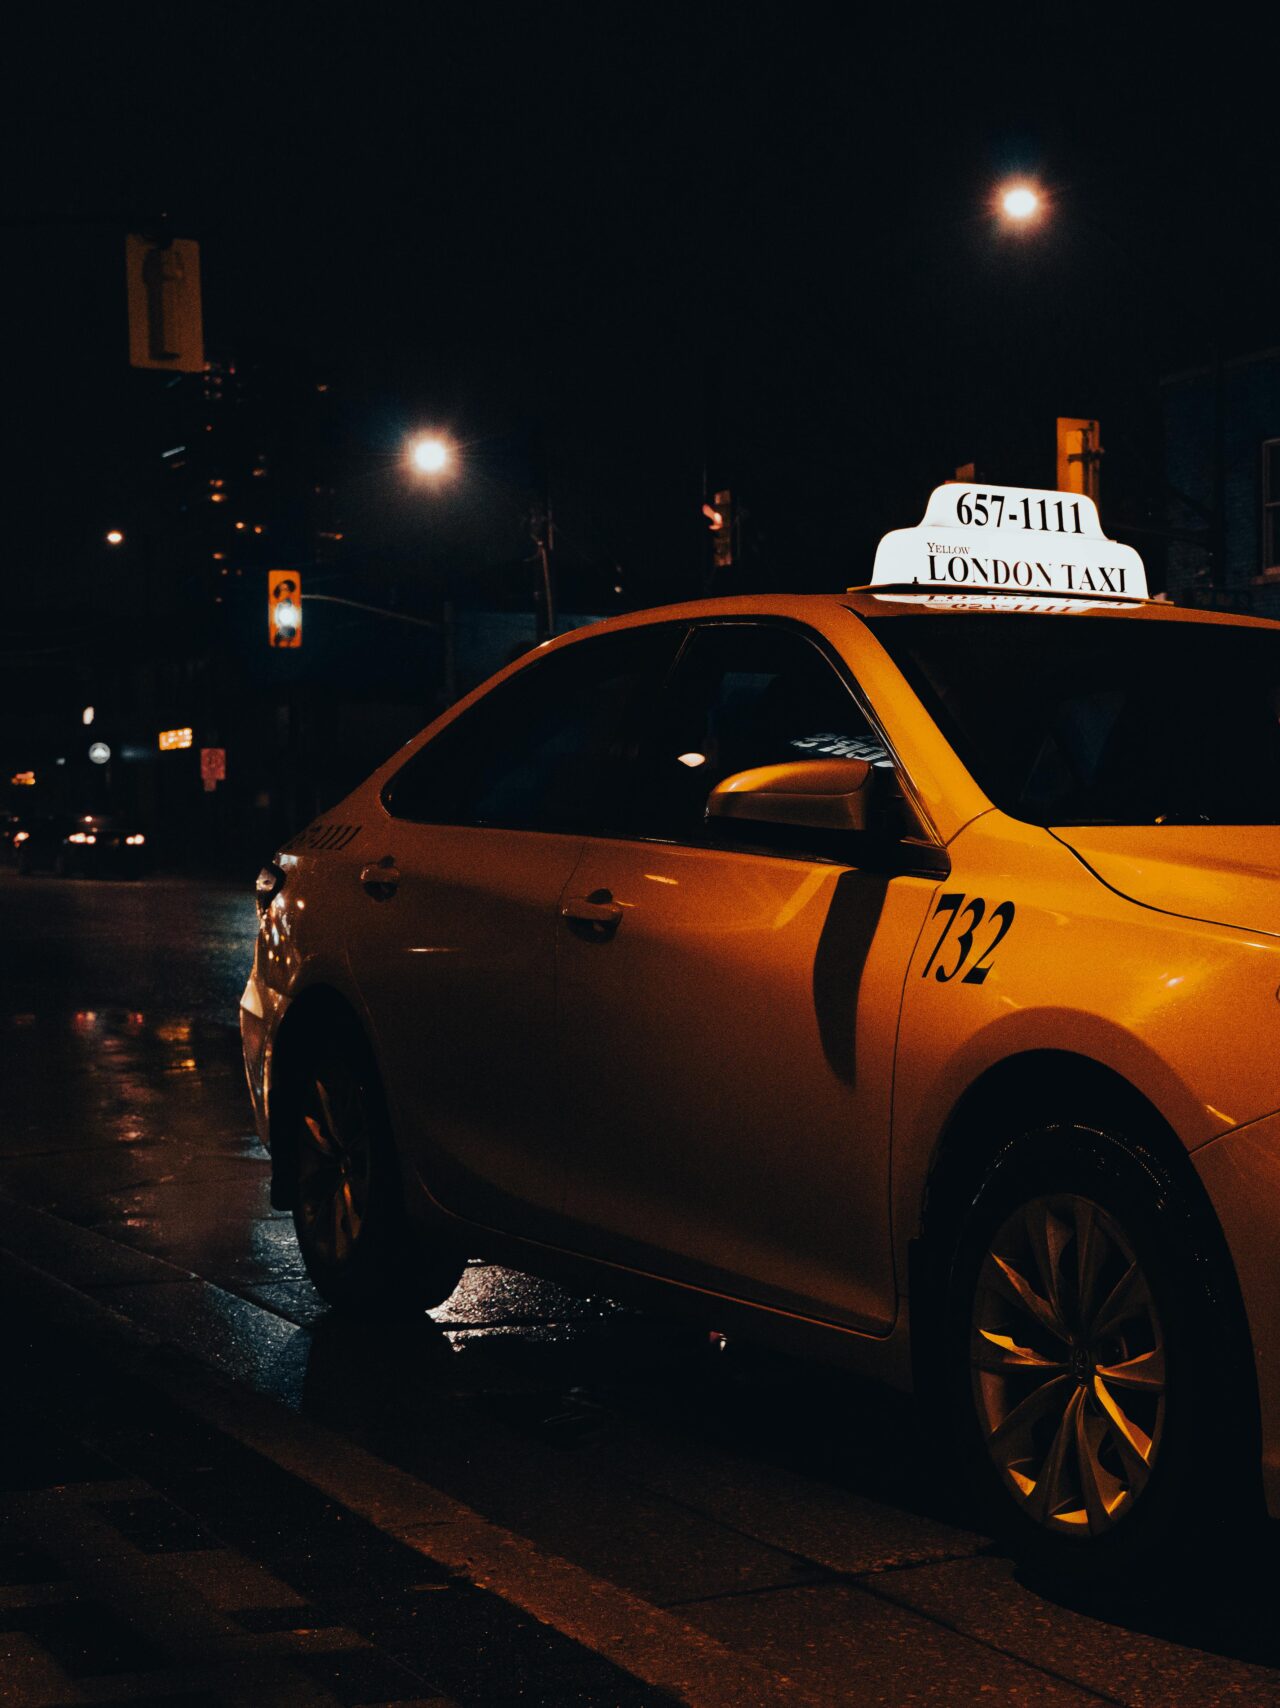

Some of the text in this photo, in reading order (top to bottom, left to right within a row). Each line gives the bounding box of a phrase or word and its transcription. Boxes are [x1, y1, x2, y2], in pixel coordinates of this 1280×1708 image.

[956, 492, 1084, 534] 657-1111
[927, 554, 1127, 594] LONDON TAXI
[922, 893, 1015, 985] 732
